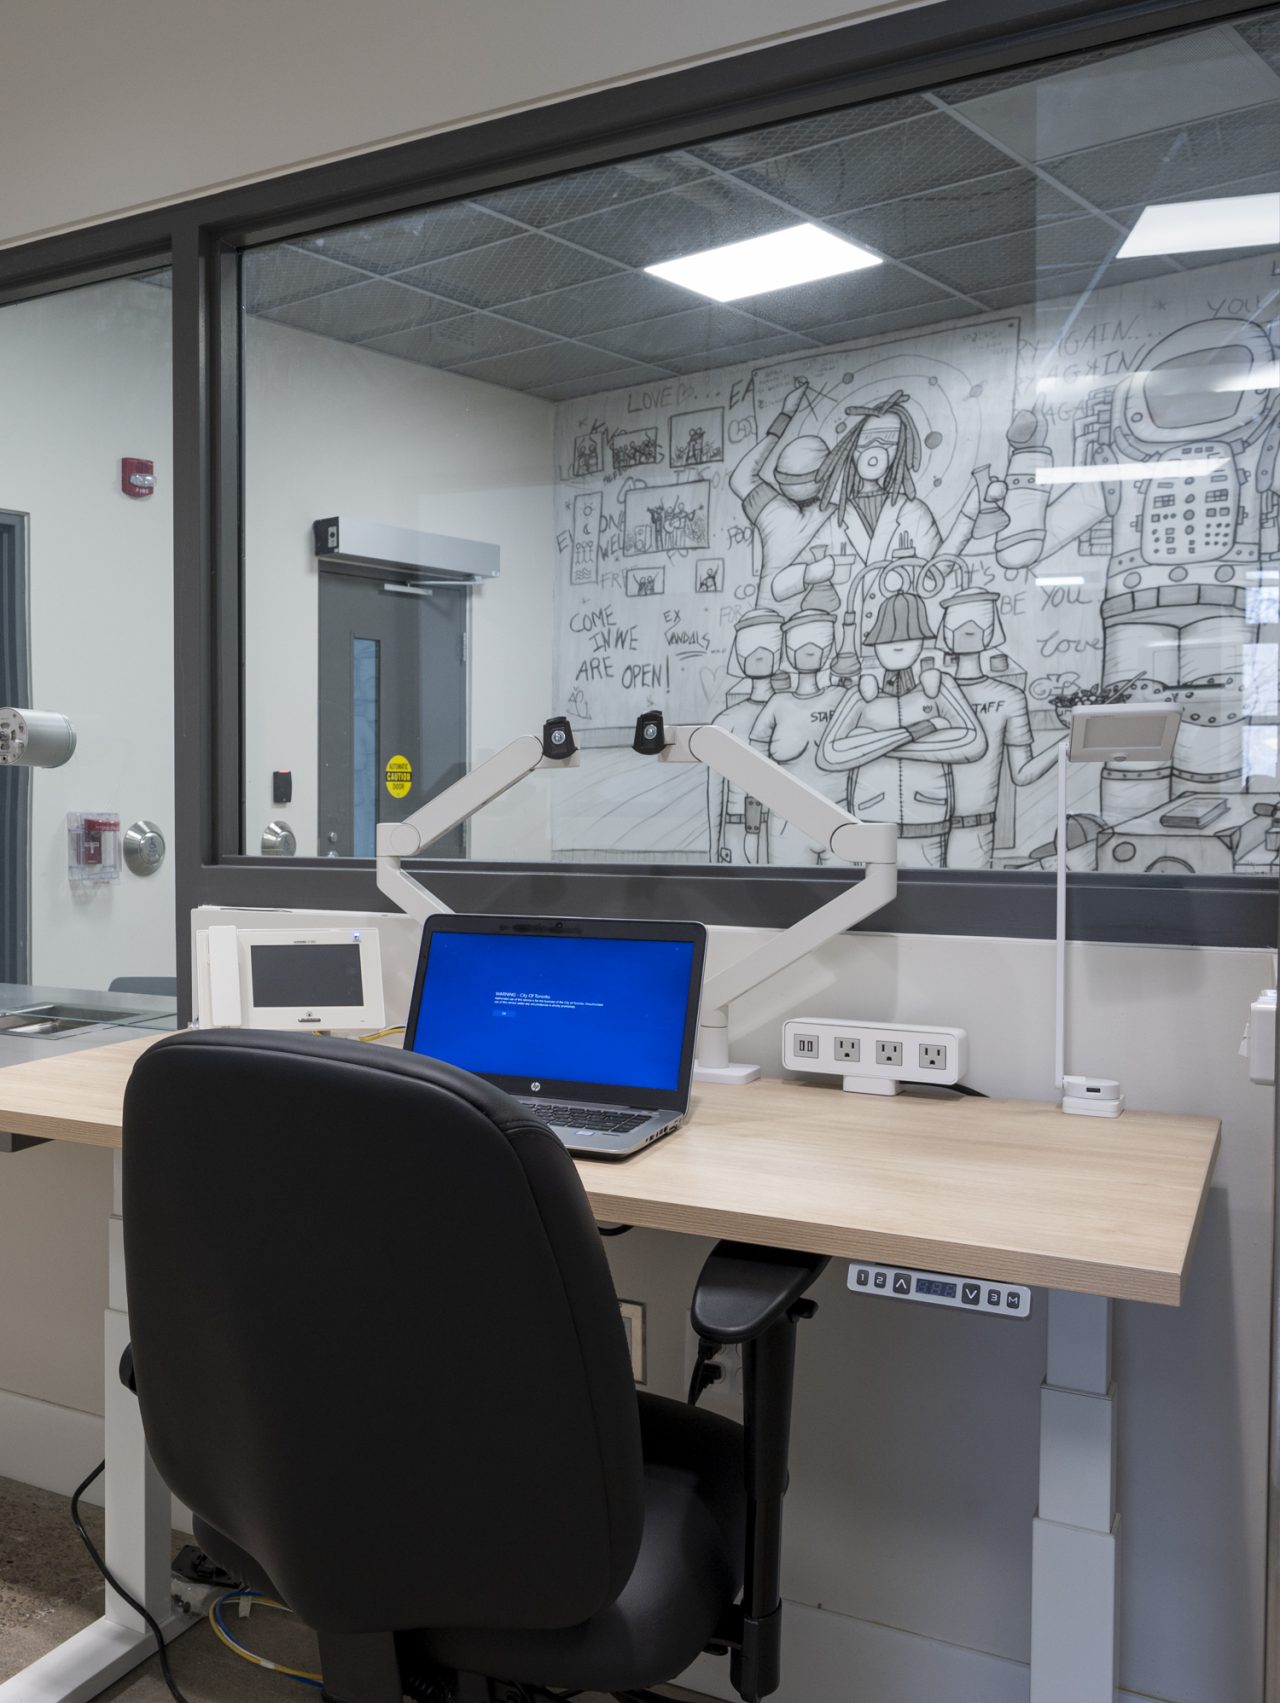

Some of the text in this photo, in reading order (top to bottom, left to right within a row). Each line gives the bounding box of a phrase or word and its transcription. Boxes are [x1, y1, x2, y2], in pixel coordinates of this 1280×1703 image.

[569, 604, 618, 633] COME
[575, 655, 671, 694] ARE OPEN!
[876, 1276, 884, 1284] 2
[990, 1293, 998, 1302] 3
[1007, 1296, 1018, 1305] M
